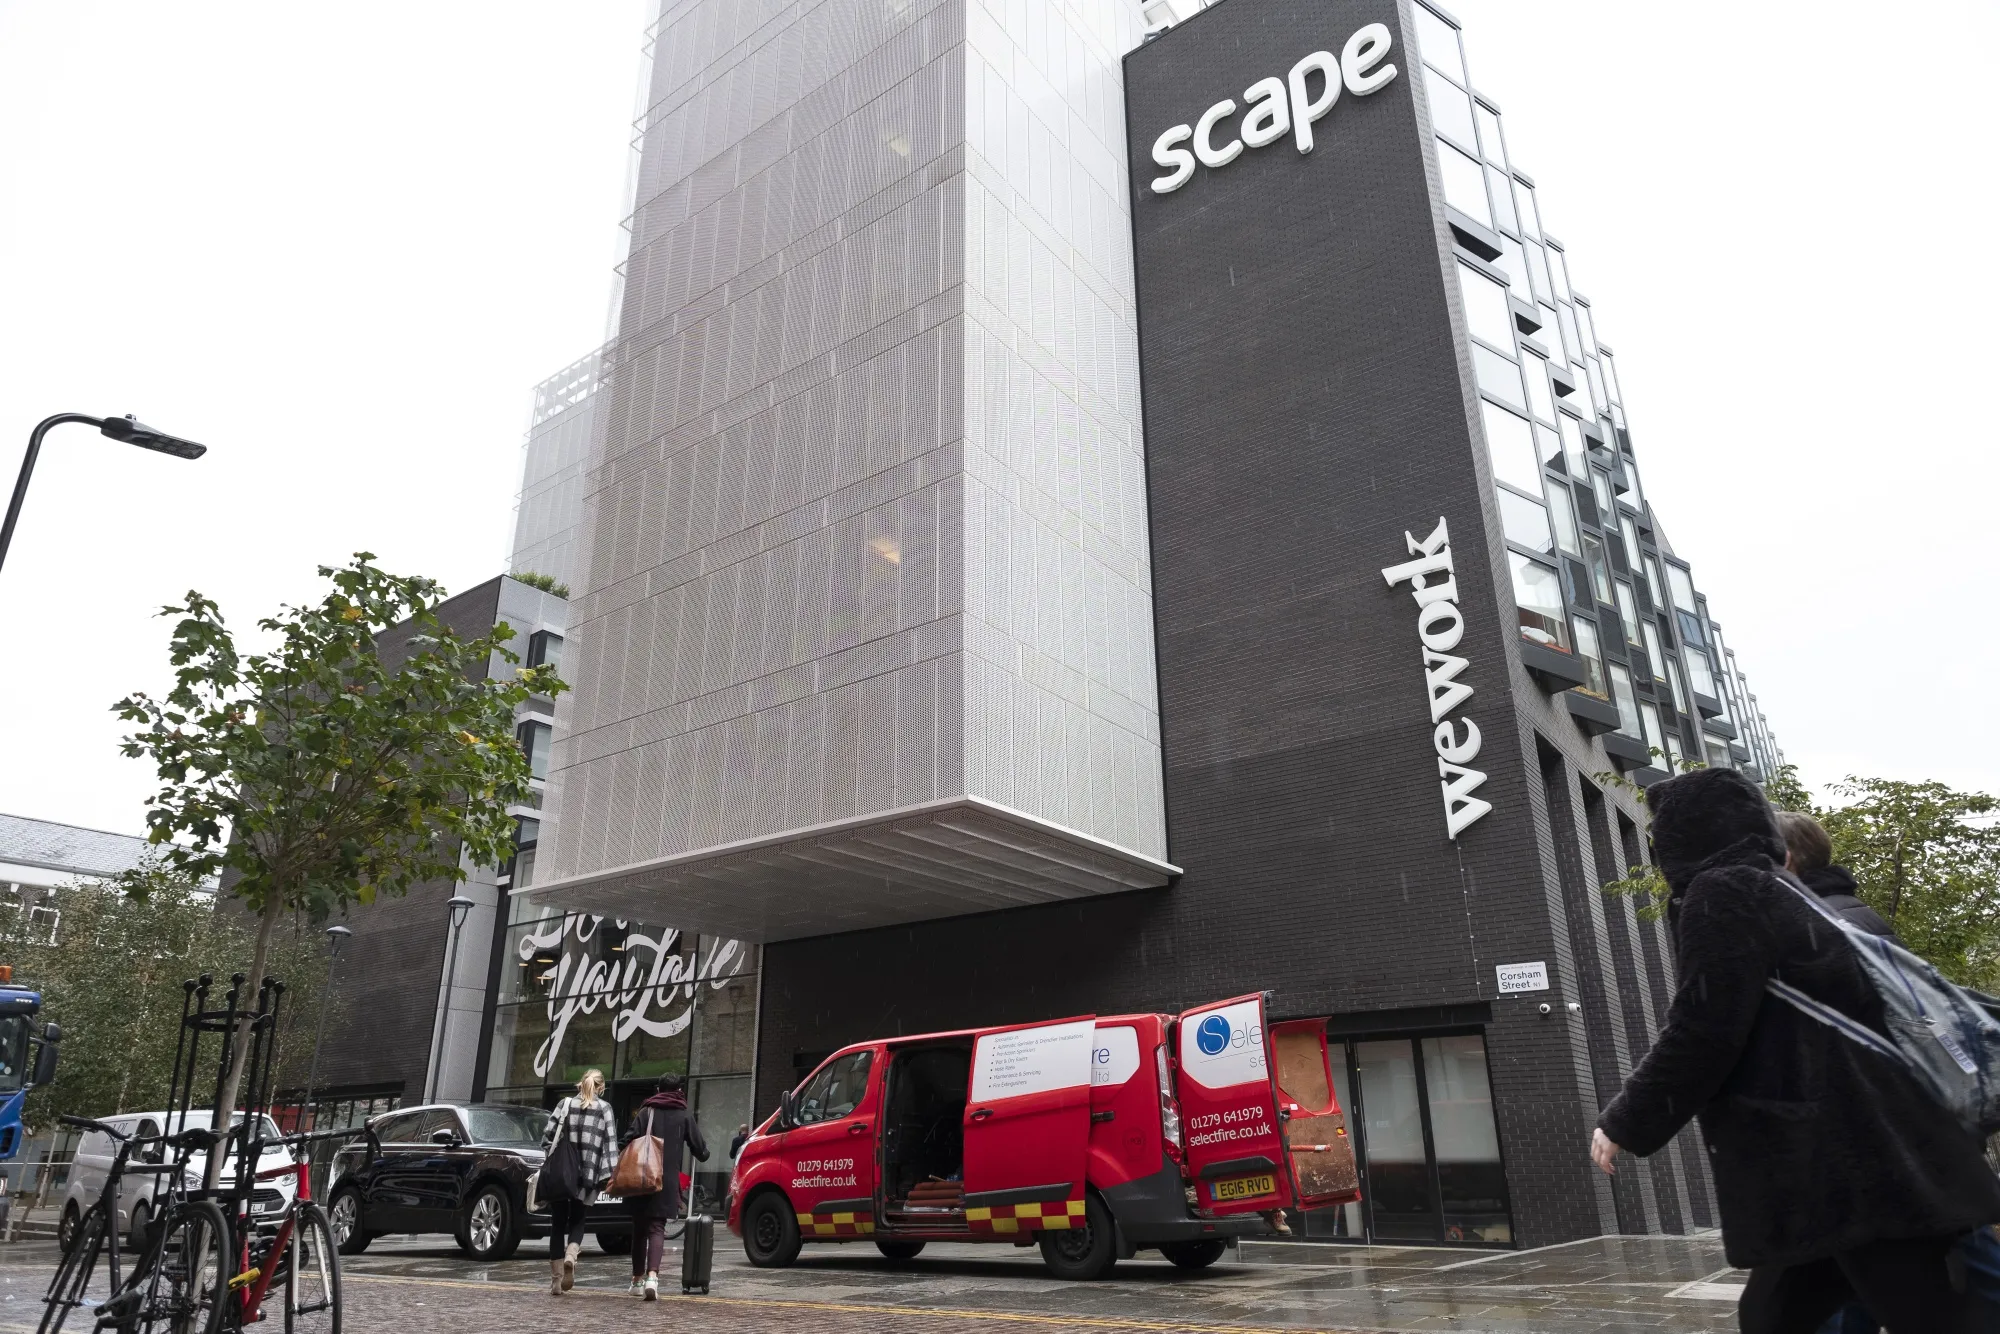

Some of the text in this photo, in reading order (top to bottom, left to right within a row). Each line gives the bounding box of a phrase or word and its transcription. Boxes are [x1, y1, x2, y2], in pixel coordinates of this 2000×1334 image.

[1151, 22, 1397, 193] scape
[1381, 515, 1492, 840] wework
[612, 927, 745, 1043] Love
[1500, 971, 1541, 981] Corsham
[1501, 980, 1531, 990] Street
[1191, 1106, 1263, 1129] 01279 641979
[1190, 1122, 1272, 1147] selectfire.co.uk
[797, 1158, 854, 1172] 01279 641979
[791, 1173, 857, 1188] selectfire.co.uk
[1220, 1177, 1270, 1197] EG16 RVO
[251, 1203, 263, 1212] LJ
